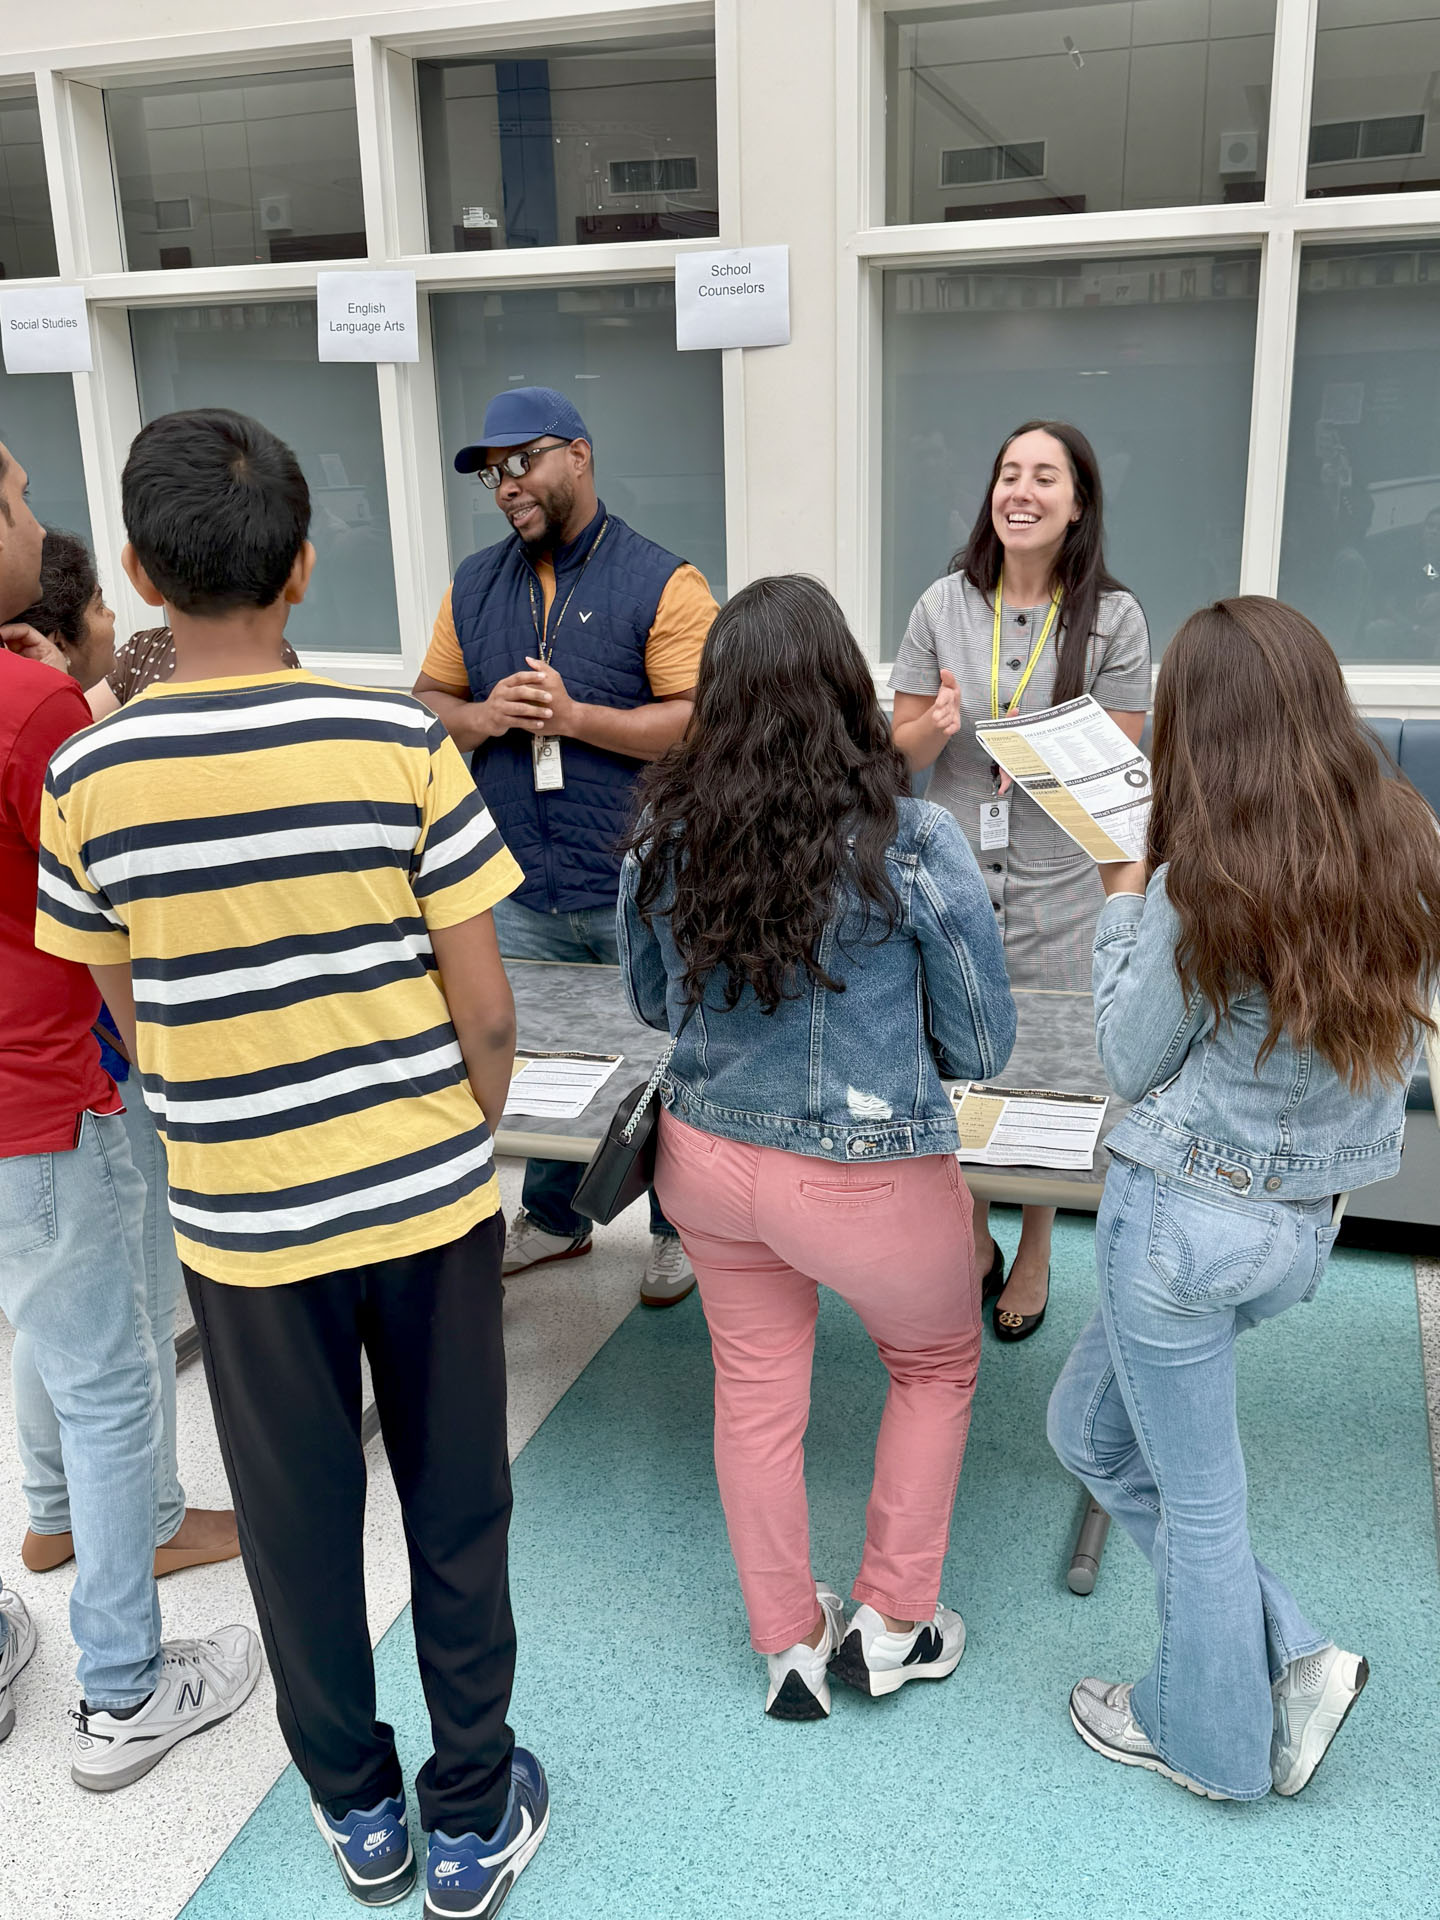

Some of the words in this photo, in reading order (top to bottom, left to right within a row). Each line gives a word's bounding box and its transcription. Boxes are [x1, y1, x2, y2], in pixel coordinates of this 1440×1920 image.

[711, 262, 751, 277] School
[698, 282, 765, 297] Counselors
[348, 302, 386, 316] English
[10, 318, 39, 330] Social
[42, 317, 78, 329] Studies
[329, 320, 381, 334] Language
[384, 320, 405, 331] Arts
[177, 1678, 204, 1711] N
[367, 1828, 387, 1845] NIKE
[369, 1846, 391, 1858] AIR
[439, 1860, 461, 1873] NIKE
[438, 1879, 460, 1887] AIR
